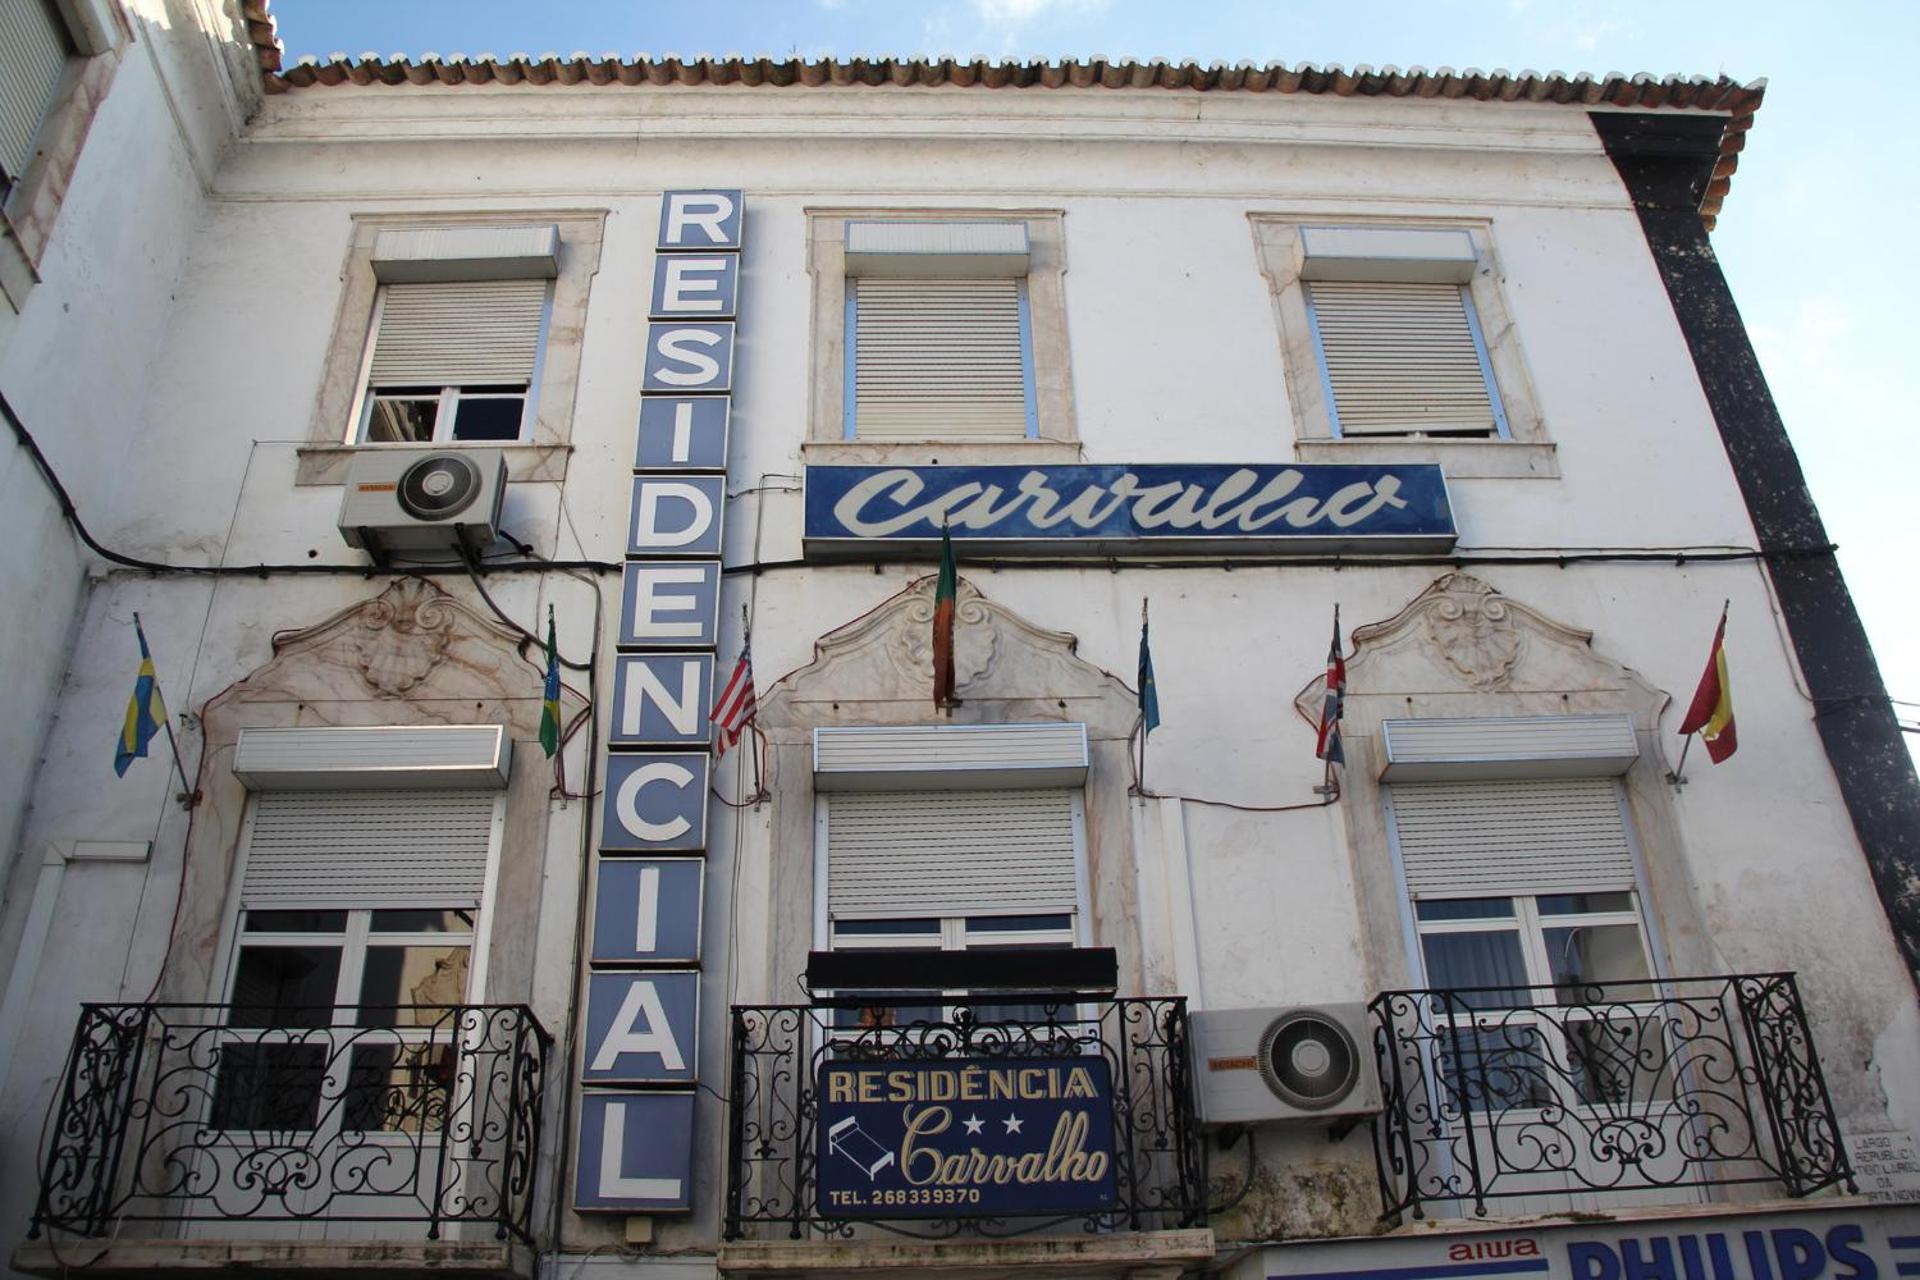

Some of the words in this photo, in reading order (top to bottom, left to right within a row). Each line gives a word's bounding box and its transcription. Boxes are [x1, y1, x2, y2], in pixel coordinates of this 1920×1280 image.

[833, 467, 1407, 538] Carvalho
[590, 194, 734, 1199] RESIDENCIAL
[828, 1064, 1098, 1103] RESIDÊNCIA
[901, 1103, 1109, 1185] Carvalho
[829, 1191, 866, 1206] TEL.
[872, 1189, 980, 1205] 268339370
[1448, 1238, 1540, 1261] aiwa
[1567, 1224, 1878, 1280] PHILIPS
